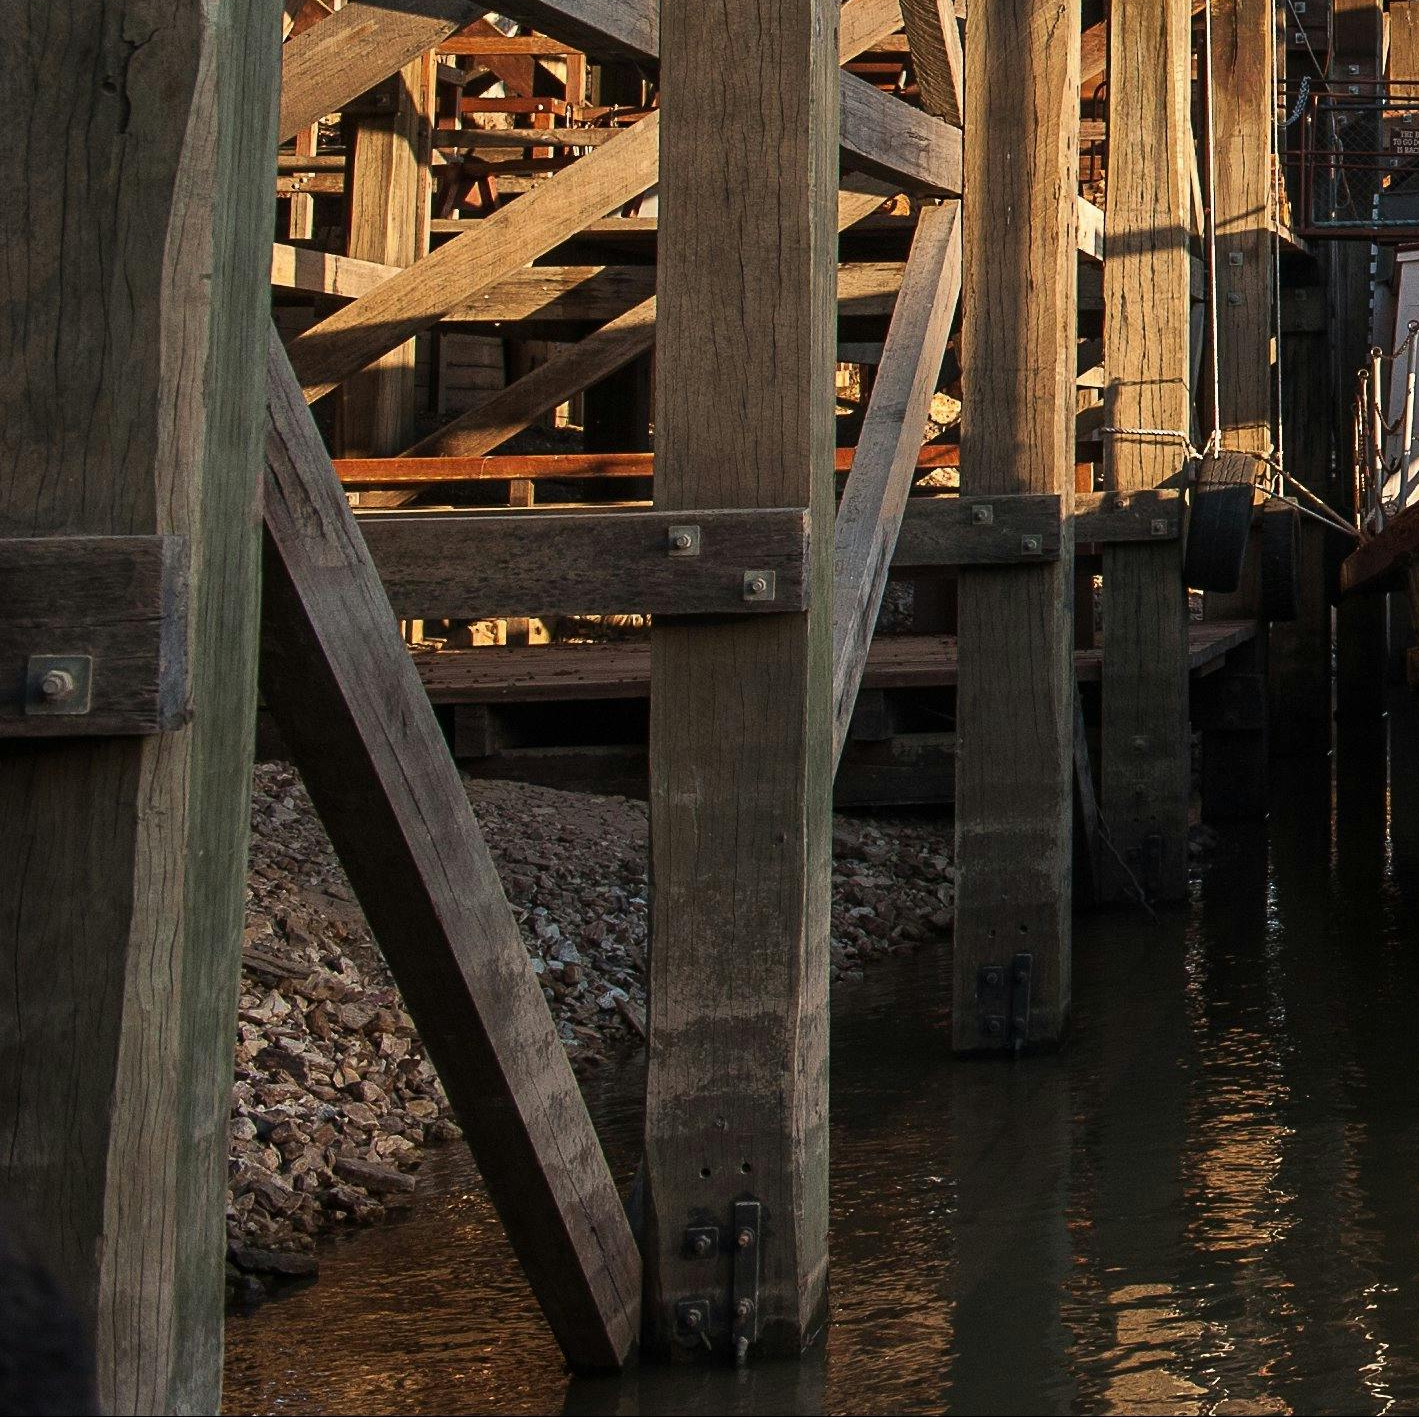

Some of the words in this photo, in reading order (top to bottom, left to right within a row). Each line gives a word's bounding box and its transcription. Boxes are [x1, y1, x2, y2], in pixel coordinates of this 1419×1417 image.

[1400, 130, 1413, 138] THE
[1393, 138, 1402, 146] TO
[1403, 138, 1412, 146] GO
